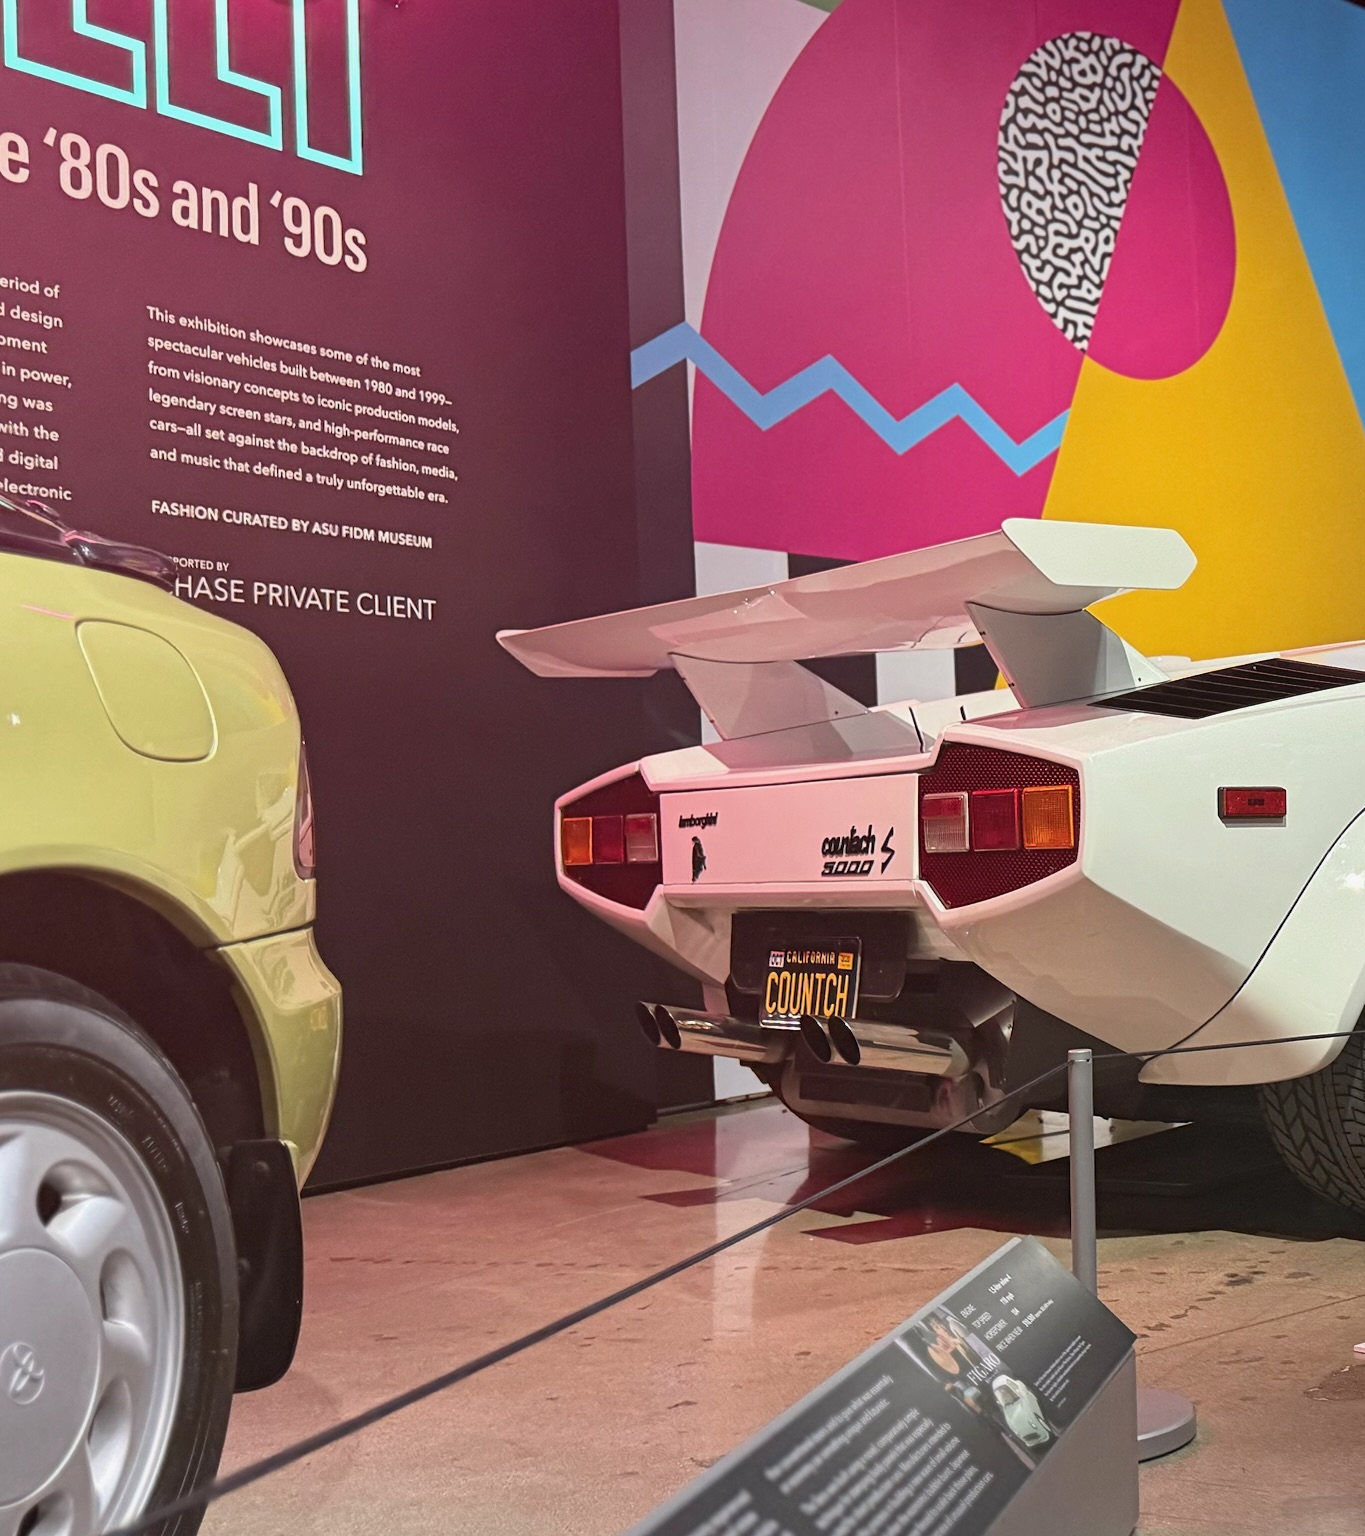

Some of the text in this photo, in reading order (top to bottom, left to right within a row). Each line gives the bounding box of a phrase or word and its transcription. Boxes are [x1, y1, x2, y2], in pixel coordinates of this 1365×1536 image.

[43, 127, 160, 218] '80s
[171, 179, 260, 246] and
[270, 190, 368, 273] '90s
[44, 285, 60, 299] of
[10, 305, 63, 330] design
[146, 305, 420, 377] This exhibition showcases some of the most
[2, 361, 72, 389] in power,
[148, 337, 223, 360] spectacular
[226, 352, 277, 371] vehicles
[280, 360, 307, 378] built
[310, 366, 360, 388] between
[364, 378, 392, 395] 1980
[395, 386, 416, 400] and
[22, 397, 54, 412] was
[147, 360, 459, 433] from visionary concepts to iconic production models,
[33, 424, 60, 441] the
[149, 387, 449, 454] legendary screen stars, and high-performance race
[8, 450, 59, 470] digital
[150, 448, 448, 503] and music that defined a truly unforgettable era.
[205, 429, 224, 441] set
[228, 433, 274, 449] against
[277, 438, 297, 452] the
[301, 441, 358, 465] backdrop
[361, 453, 373, 465] of
[375, 454, 419, 474] fashion,
[421, 465, 457, 481] media,
[152, 500, 432, 548] FASHION CURATED BY ASU FIDM MUSEUM
[168, 556, 229, 571] PORTED BY
[169, 575, 436, 620] HASE PRIVATE CLIENT
[786, 951, 836, 965] CALIFORNIA
[765, 971, 849, 1017] COUNTCH
[966, 1352, 1001, 1386] FIGARO
